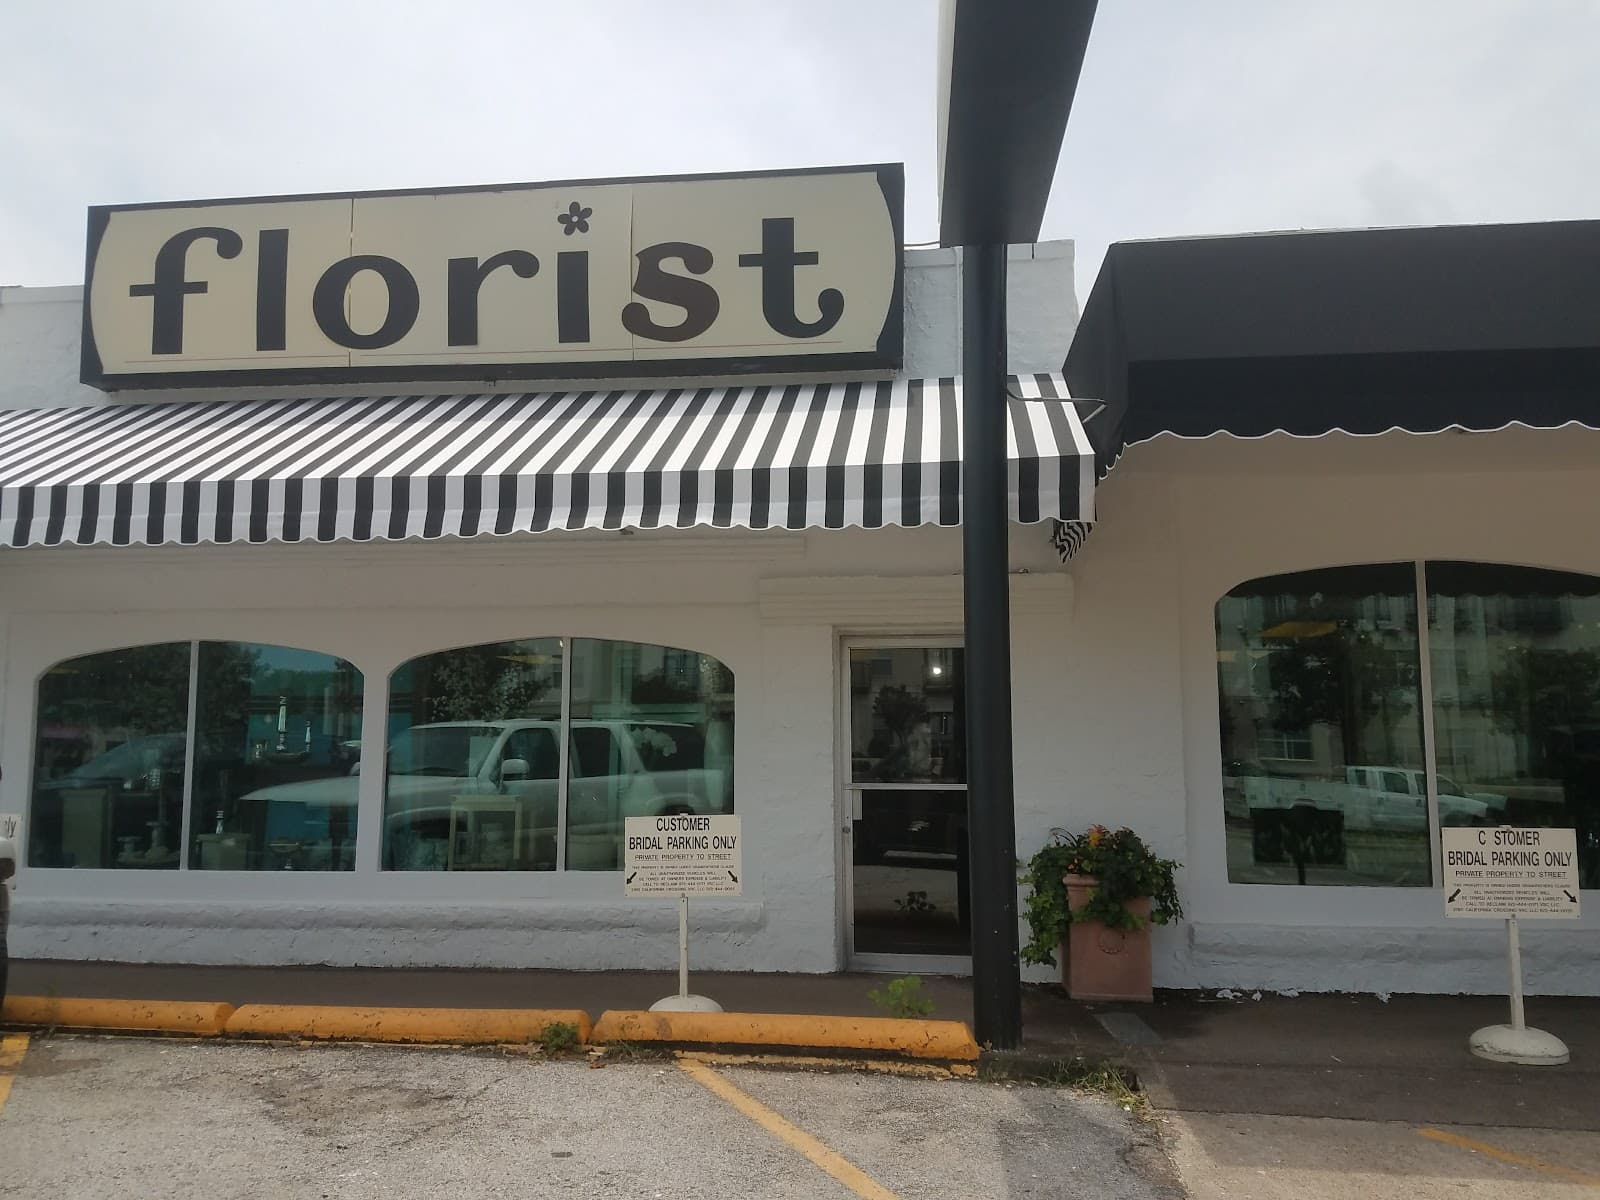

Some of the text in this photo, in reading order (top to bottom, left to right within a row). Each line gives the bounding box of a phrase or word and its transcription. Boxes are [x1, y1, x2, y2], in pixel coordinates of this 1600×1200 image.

[129, 202, 844, 355] florist
[656, 817, 710, 831] CUSTOMER
[629, 835, 737, 850] BRIDAL PARKING ONLY
[707, 853, 732, 861] STREET
[1448, 850, 1572, 867] BRIDAL PARKING ONLY
